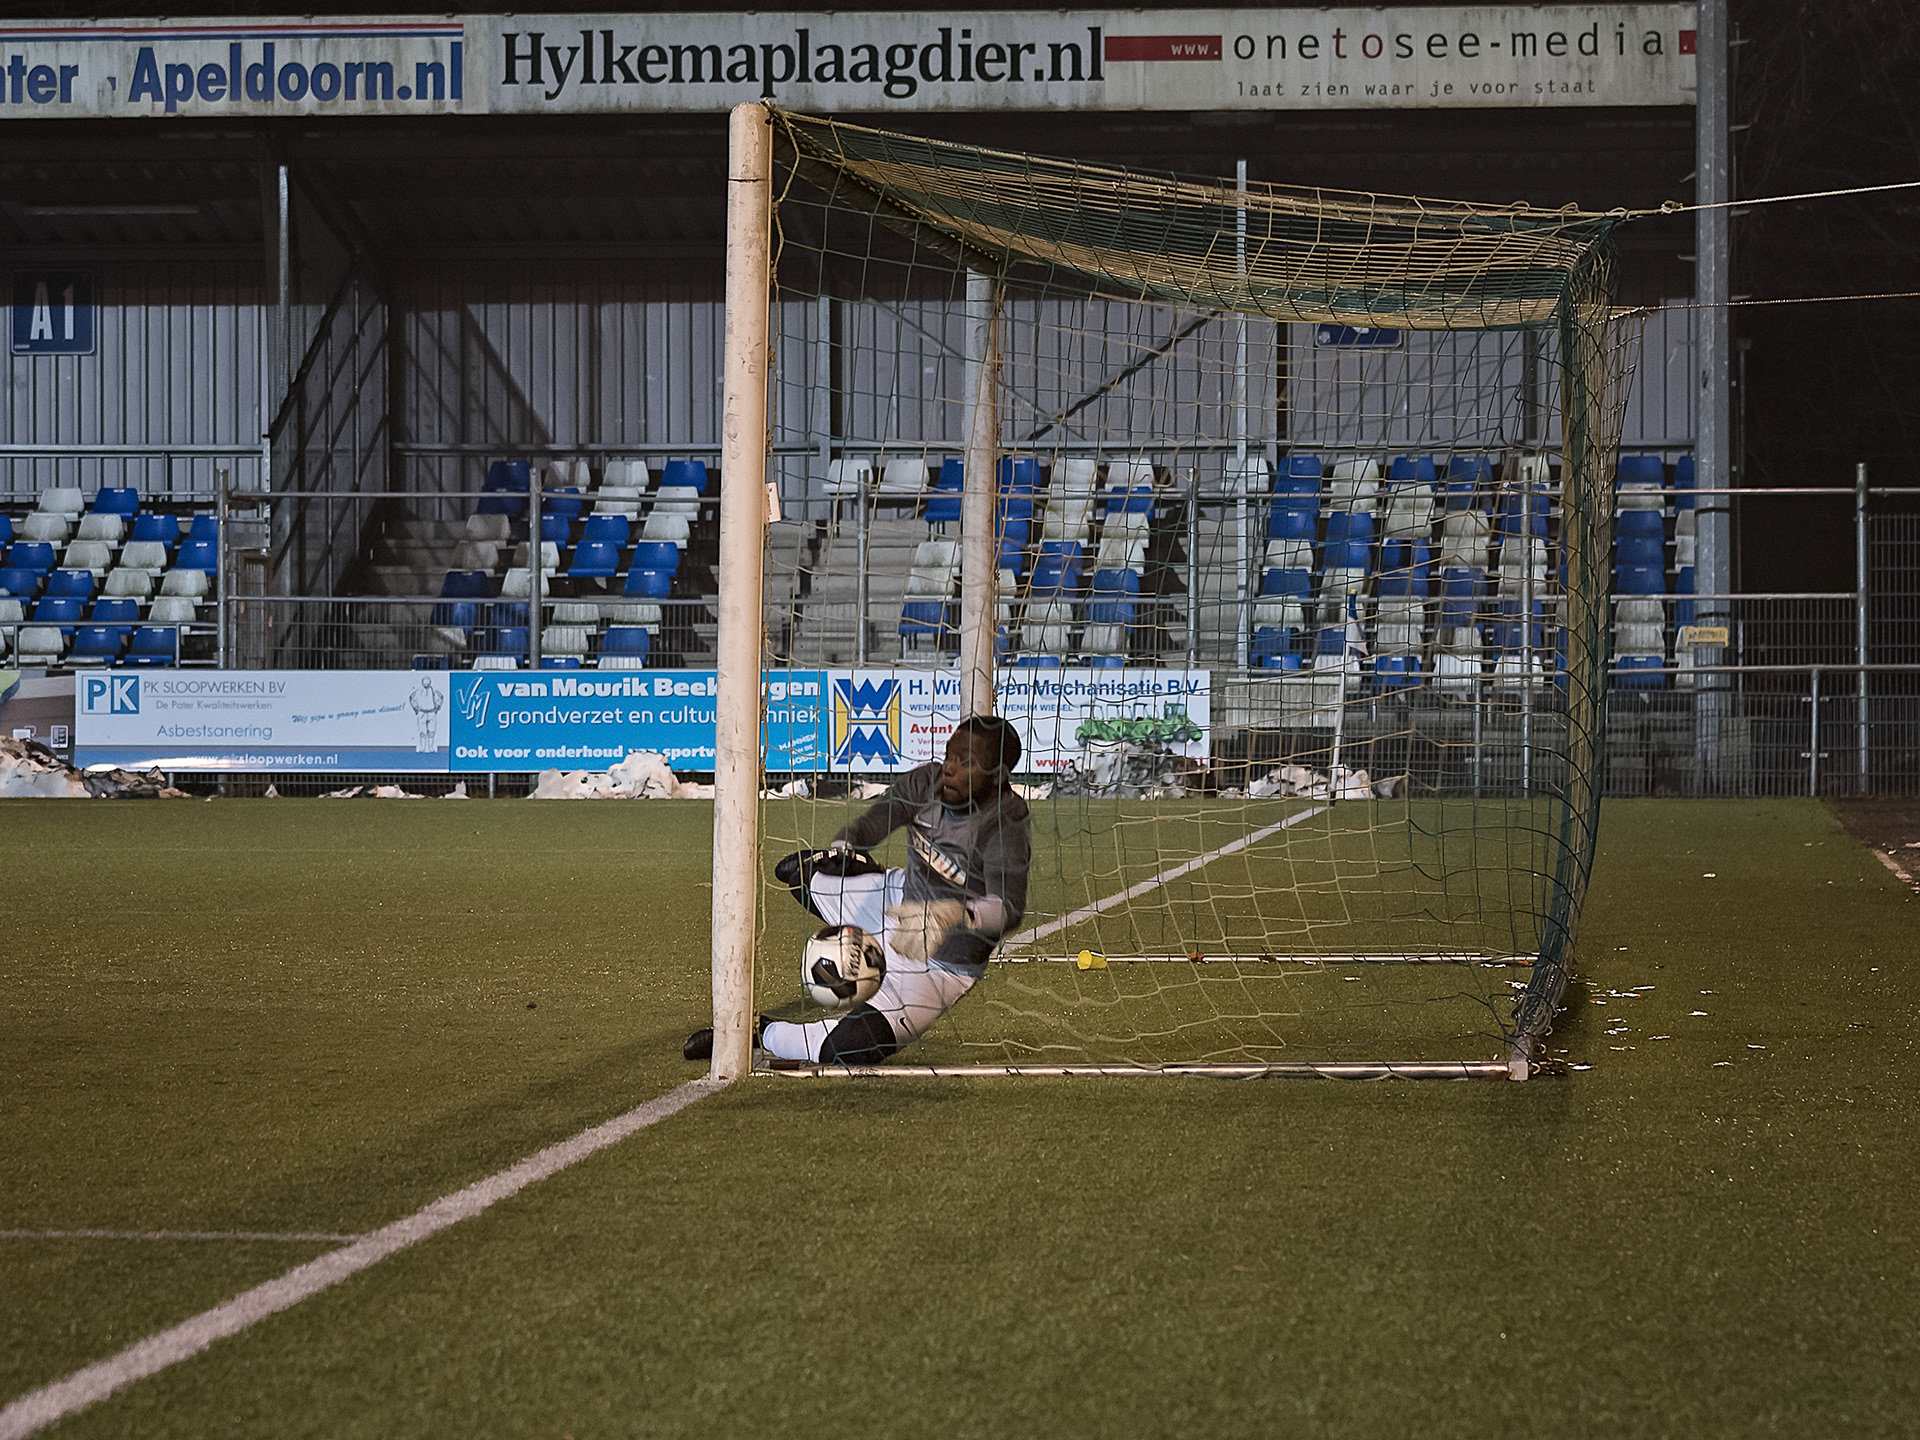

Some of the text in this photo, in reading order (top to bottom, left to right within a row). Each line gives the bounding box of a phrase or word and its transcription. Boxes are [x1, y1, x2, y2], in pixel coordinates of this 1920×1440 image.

[501, 27, 1104, 99] Hylkemaplaagdier.nl
[0, 41, 463, 112] ter Apeldoorn.nl
[1237, 79, 1595, 97] laat zien waar je voor staat
[30, 282, 74, 340] A1
[87, 679, 137, 711] PK
[143, 681, 286, 694] PK SLOOPWERKEN BV
[497, 683, 547, 697] van
[552, 677, 649, 697] Mourik
[909, 680, 929, 695] H.
[1033, 679, 1162, 696] Mechanisatie
[1167, 680, 1204, 695] B.V.
[156, 700, 273, 710] De Pater Kwaliteitswerken
[498, 706, 623, 729] grondverzet
[628, 710, 653, 723] en
[156, 724, 273, 741] Asbestsanering
[910, 723, 953, 734] Avant
[455, 745, 488, 758] Ook
[494, 748, 531, 758] voor
[535, 745, 623, 758] onderhoud
